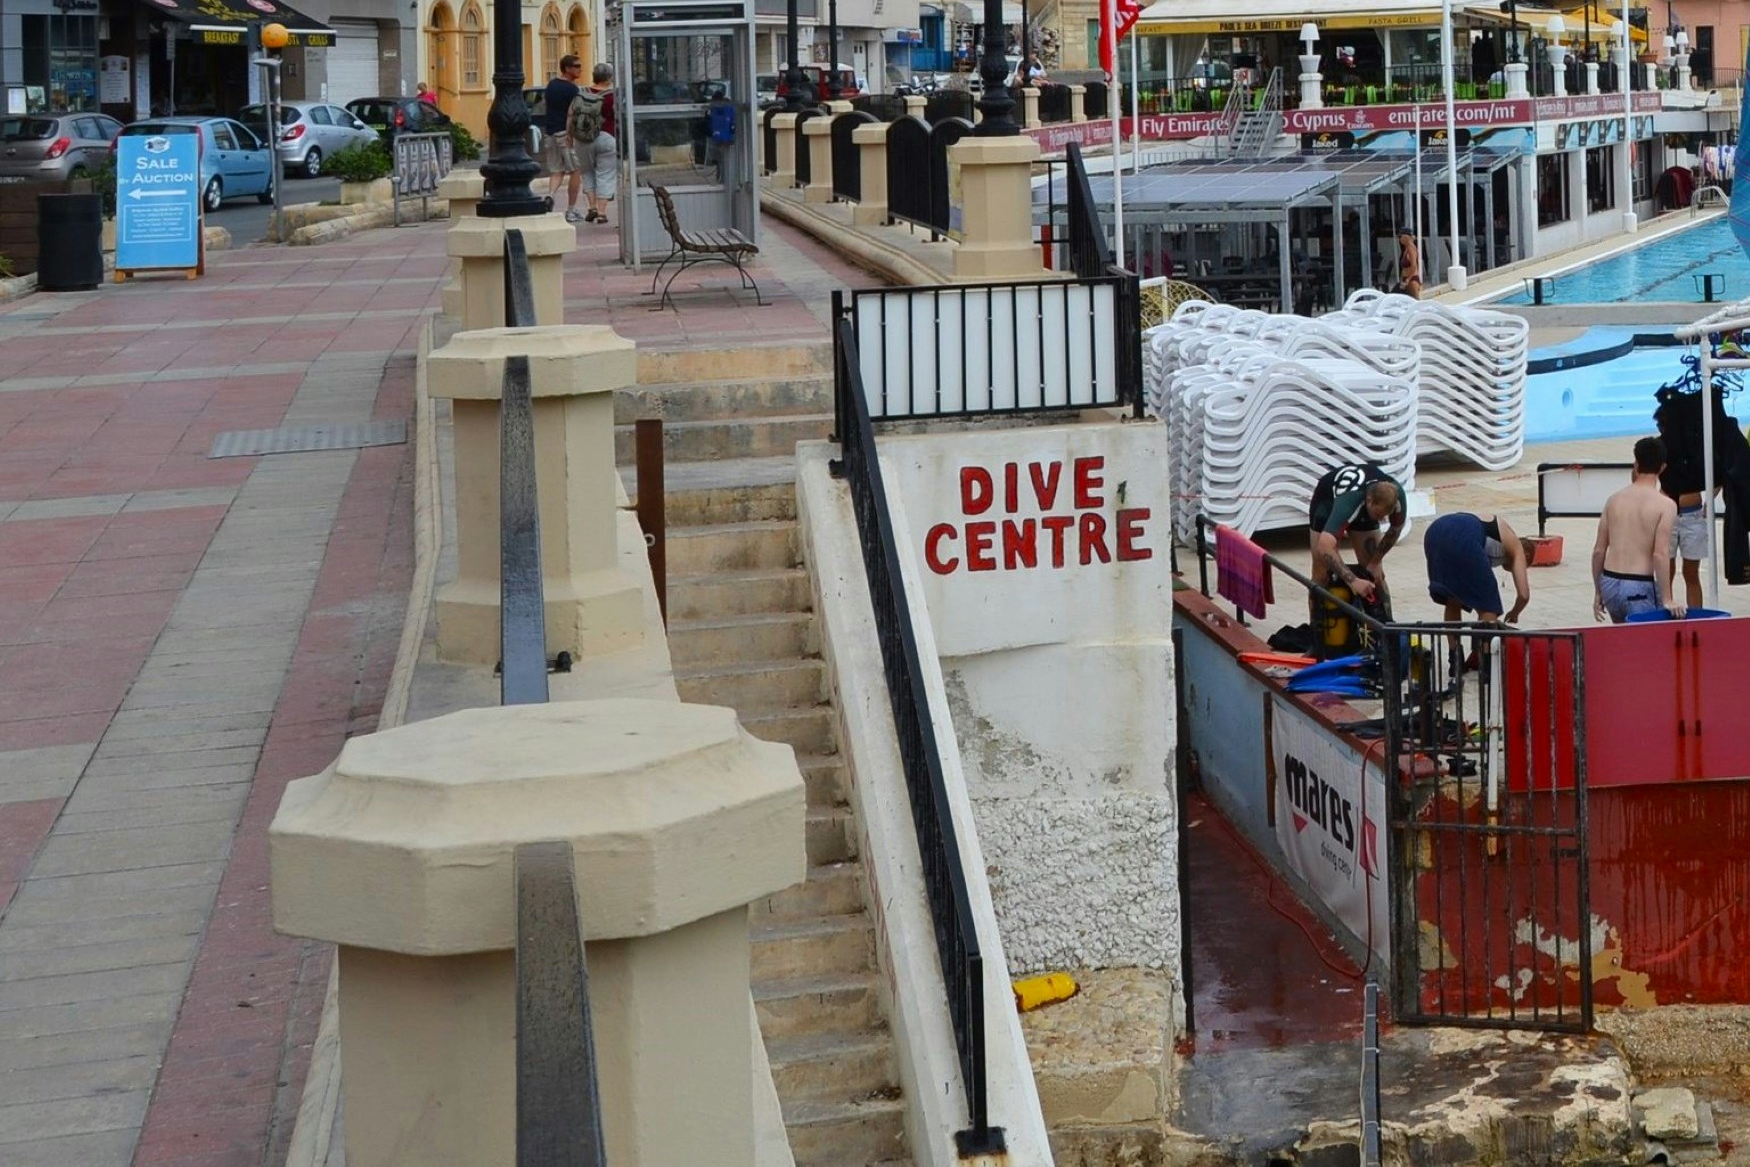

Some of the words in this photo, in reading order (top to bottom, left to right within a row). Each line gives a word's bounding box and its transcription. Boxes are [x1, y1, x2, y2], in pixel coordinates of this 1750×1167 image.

[204, 31, 240, 44] BREAKFAST
[1142, 118, 1163, 136] Fly
[1169, 116, 1229, 133] Emirates
[1292, 111, 1346, 131] Cyprus
[1388, 103, 1515, 124] emirates.com/mt
[136, 156, 178, 170] SALE
[132, 172, 193, 184] AUCTION
[960, 456, 1104, 515] DIVE
[925, 508, 1152, 575] CENTRE
[1285, 752, 1354, 853] mares
